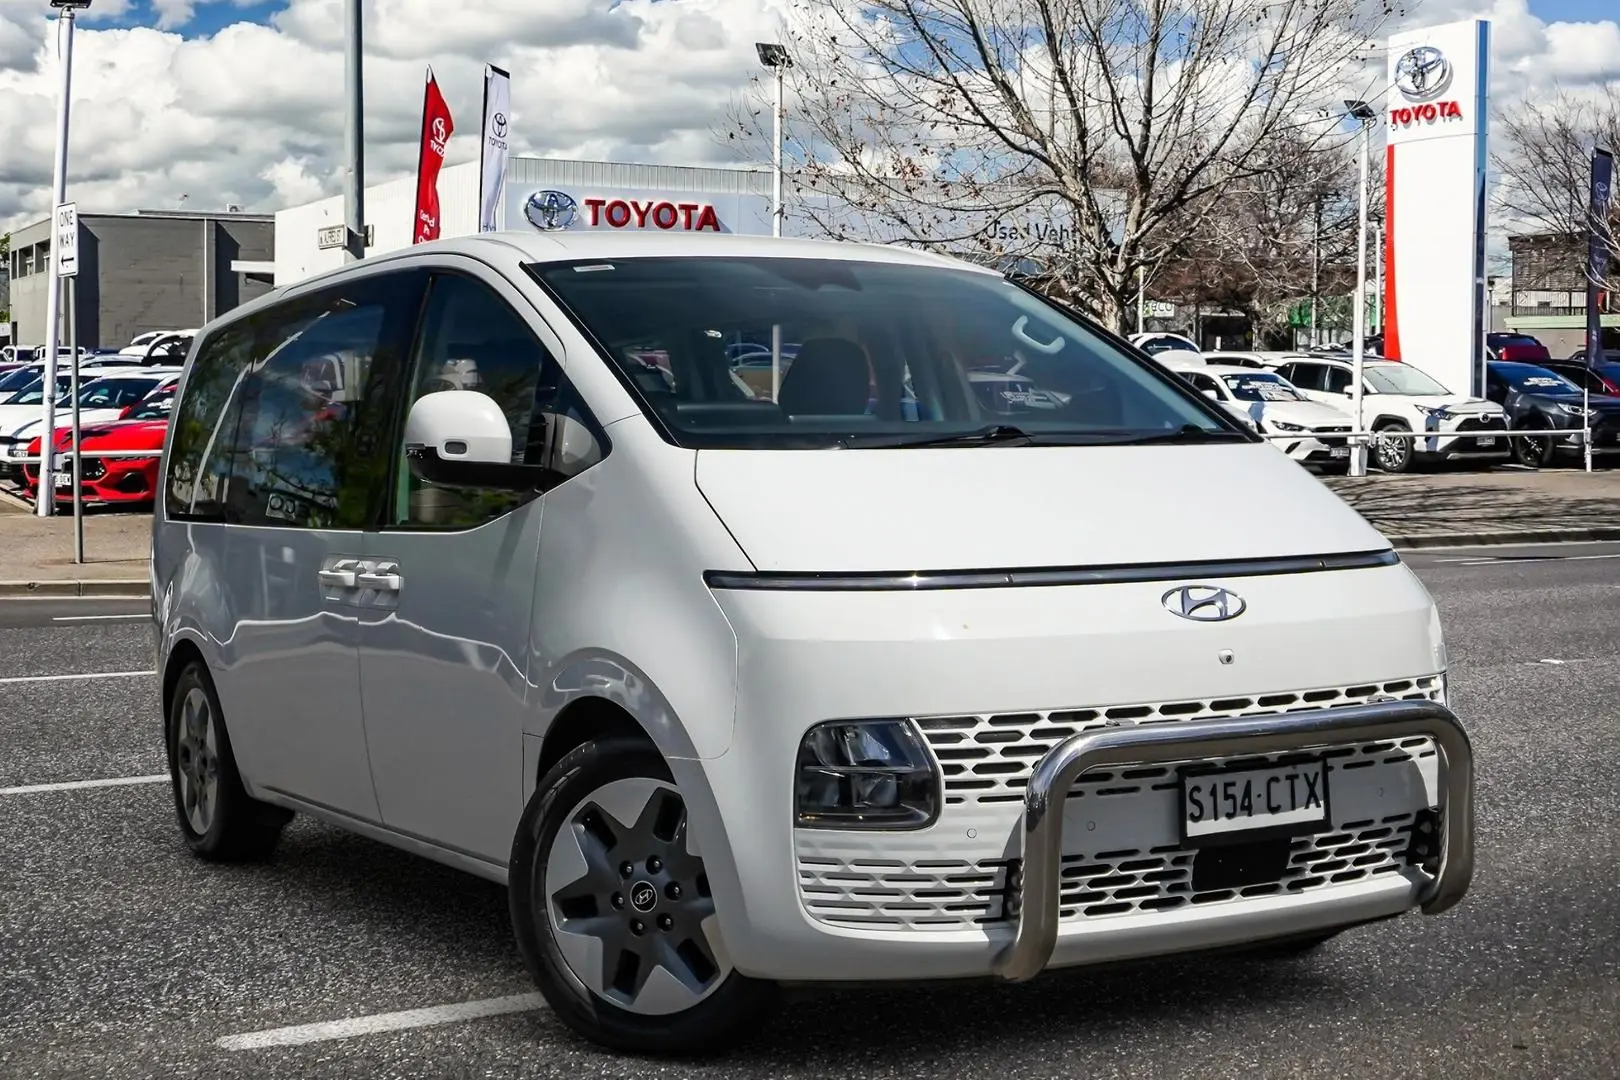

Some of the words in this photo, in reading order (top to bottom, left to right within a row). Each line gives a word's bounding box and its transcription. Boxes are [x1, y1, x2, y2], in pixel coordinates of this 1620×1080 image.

[1390, 101, 1462, 125] TOYOTA
[59, 209, 73, 227] ONE
[585, 199, 720, 232] TOYOTA
[59, 232, 75, 247] WAY
[985, 220, 1030, 240] Used
